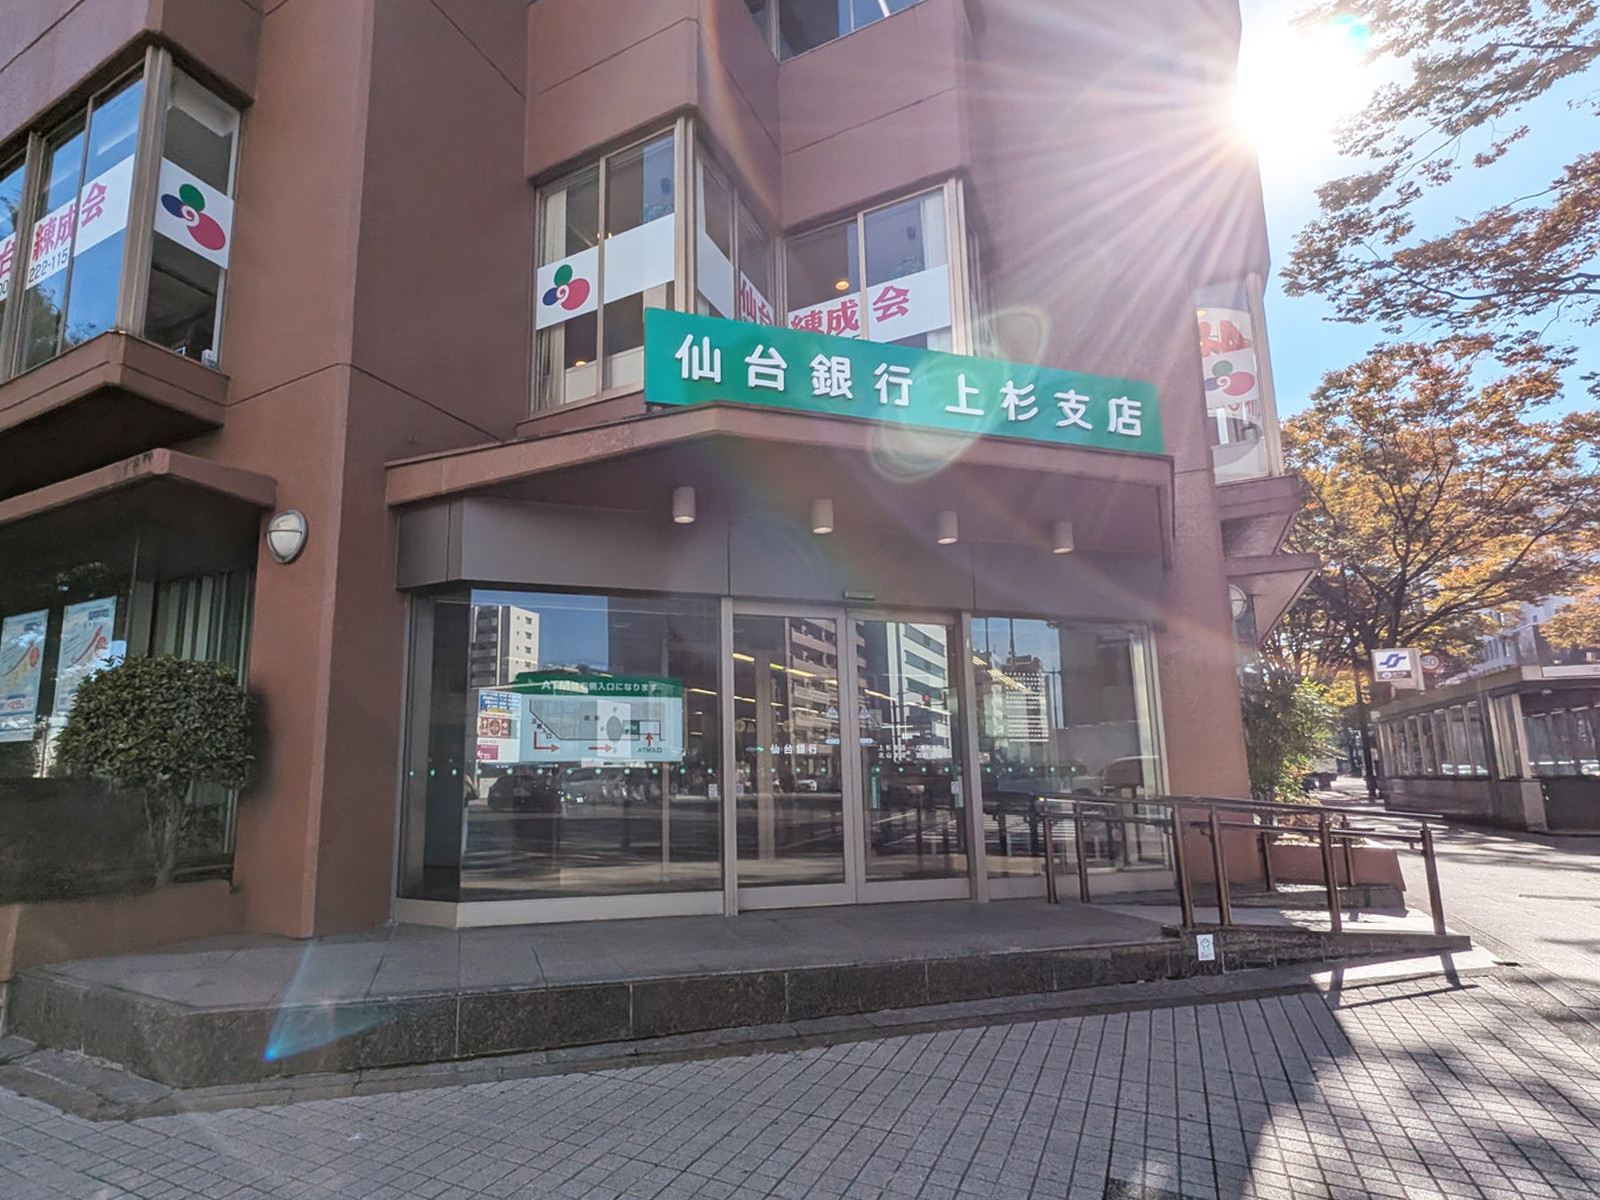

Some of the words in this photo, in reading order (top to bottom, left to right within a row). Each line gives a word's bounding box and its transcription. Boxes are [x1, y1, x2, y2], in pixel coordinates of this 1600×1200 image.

[674, 333, 913, 407] 仙台銀行
[944, 374, 1143, 437] 上杉支店
[769, 744, 818, 755] 仙台銀行
